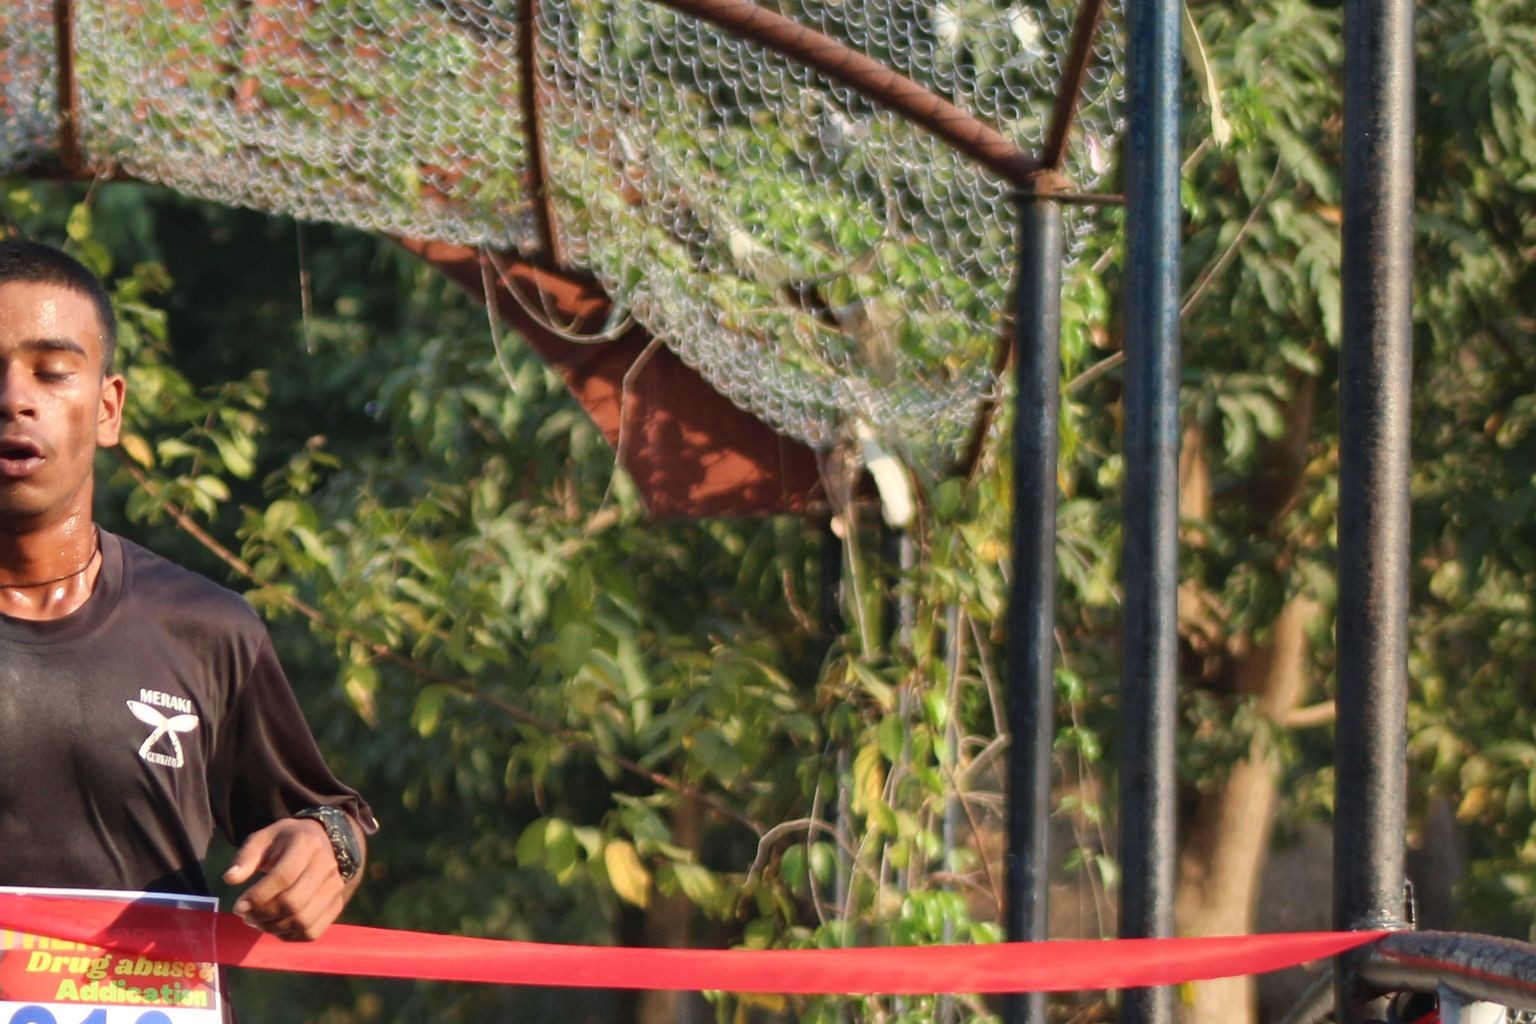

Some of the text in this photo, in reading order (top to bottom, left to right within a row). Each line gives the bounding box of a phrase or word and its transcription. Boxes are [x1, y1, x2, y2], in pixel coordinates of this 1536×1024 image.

[140, 688, 192, 713] MERAKI
[26, 951, 113, 979] Drug
[114, 956, 196, 979] abuse
[55, 978, 209, 1008] Addication
